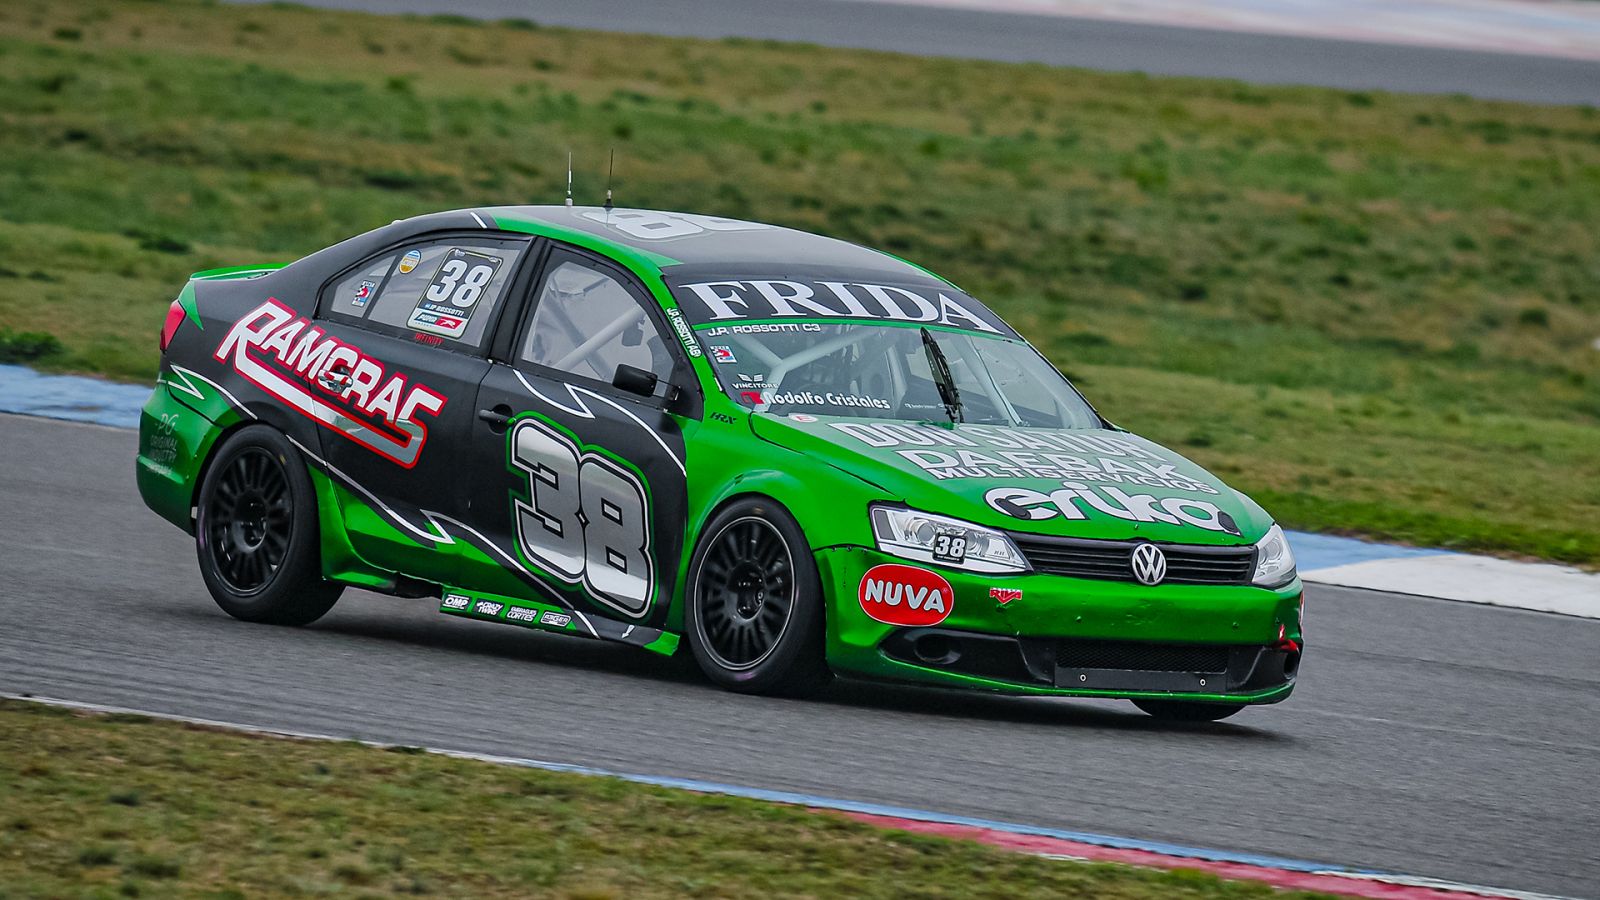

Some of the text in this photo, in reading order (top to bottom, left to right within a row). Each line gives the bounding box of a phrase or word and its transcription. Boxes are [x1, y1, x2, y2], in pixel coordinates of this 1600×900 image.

[426, 259, 493, 308] 38
[678, 280, 1006, 335] FRIDA
[708, 323, 821, 337] J.P. ROSSOTTI C3
[213, 298, 448, 468] RAMGRAS
[825, 392, 891, 410] Cristales
[827, 422, 1169, 462] DON SATUR
[894, 449, 1204, 485] DAEBAK
[925, 466, 1221, 495] MULTISERVICIOS
[511, 417, 654, 619] 38
[935, 535, 966, 558] 38
[445, 597, 469, 607] OMP
[865, 578, 945, 613] NUVA
